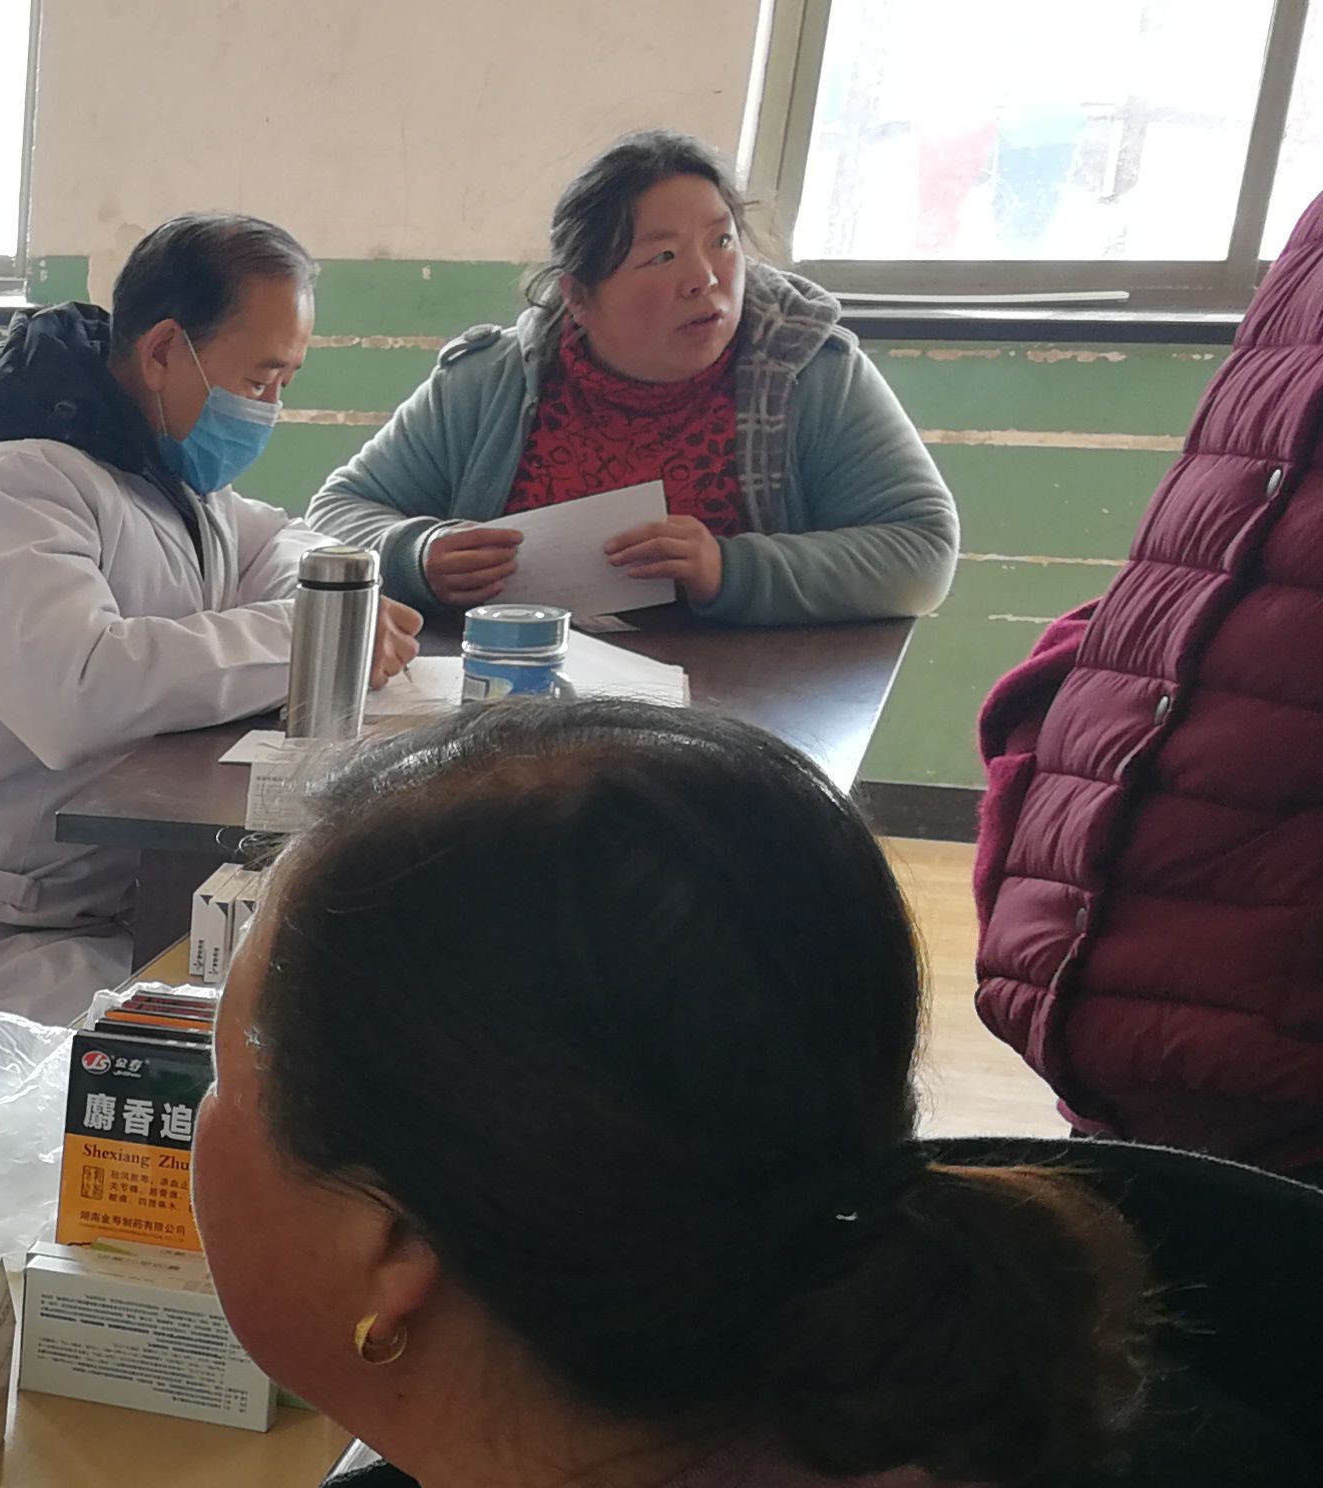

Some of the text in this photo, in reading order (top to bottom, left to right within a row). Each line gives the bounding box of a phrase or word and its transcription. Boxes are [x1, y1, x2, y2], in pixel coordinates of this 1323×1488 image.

[83, 1093, 193, 1142] 麝香追
[82, 1142, 191, 1171] Shexiang Zhu
[80, 1209, 186, 1235] 湖南金寿制药有限公司
